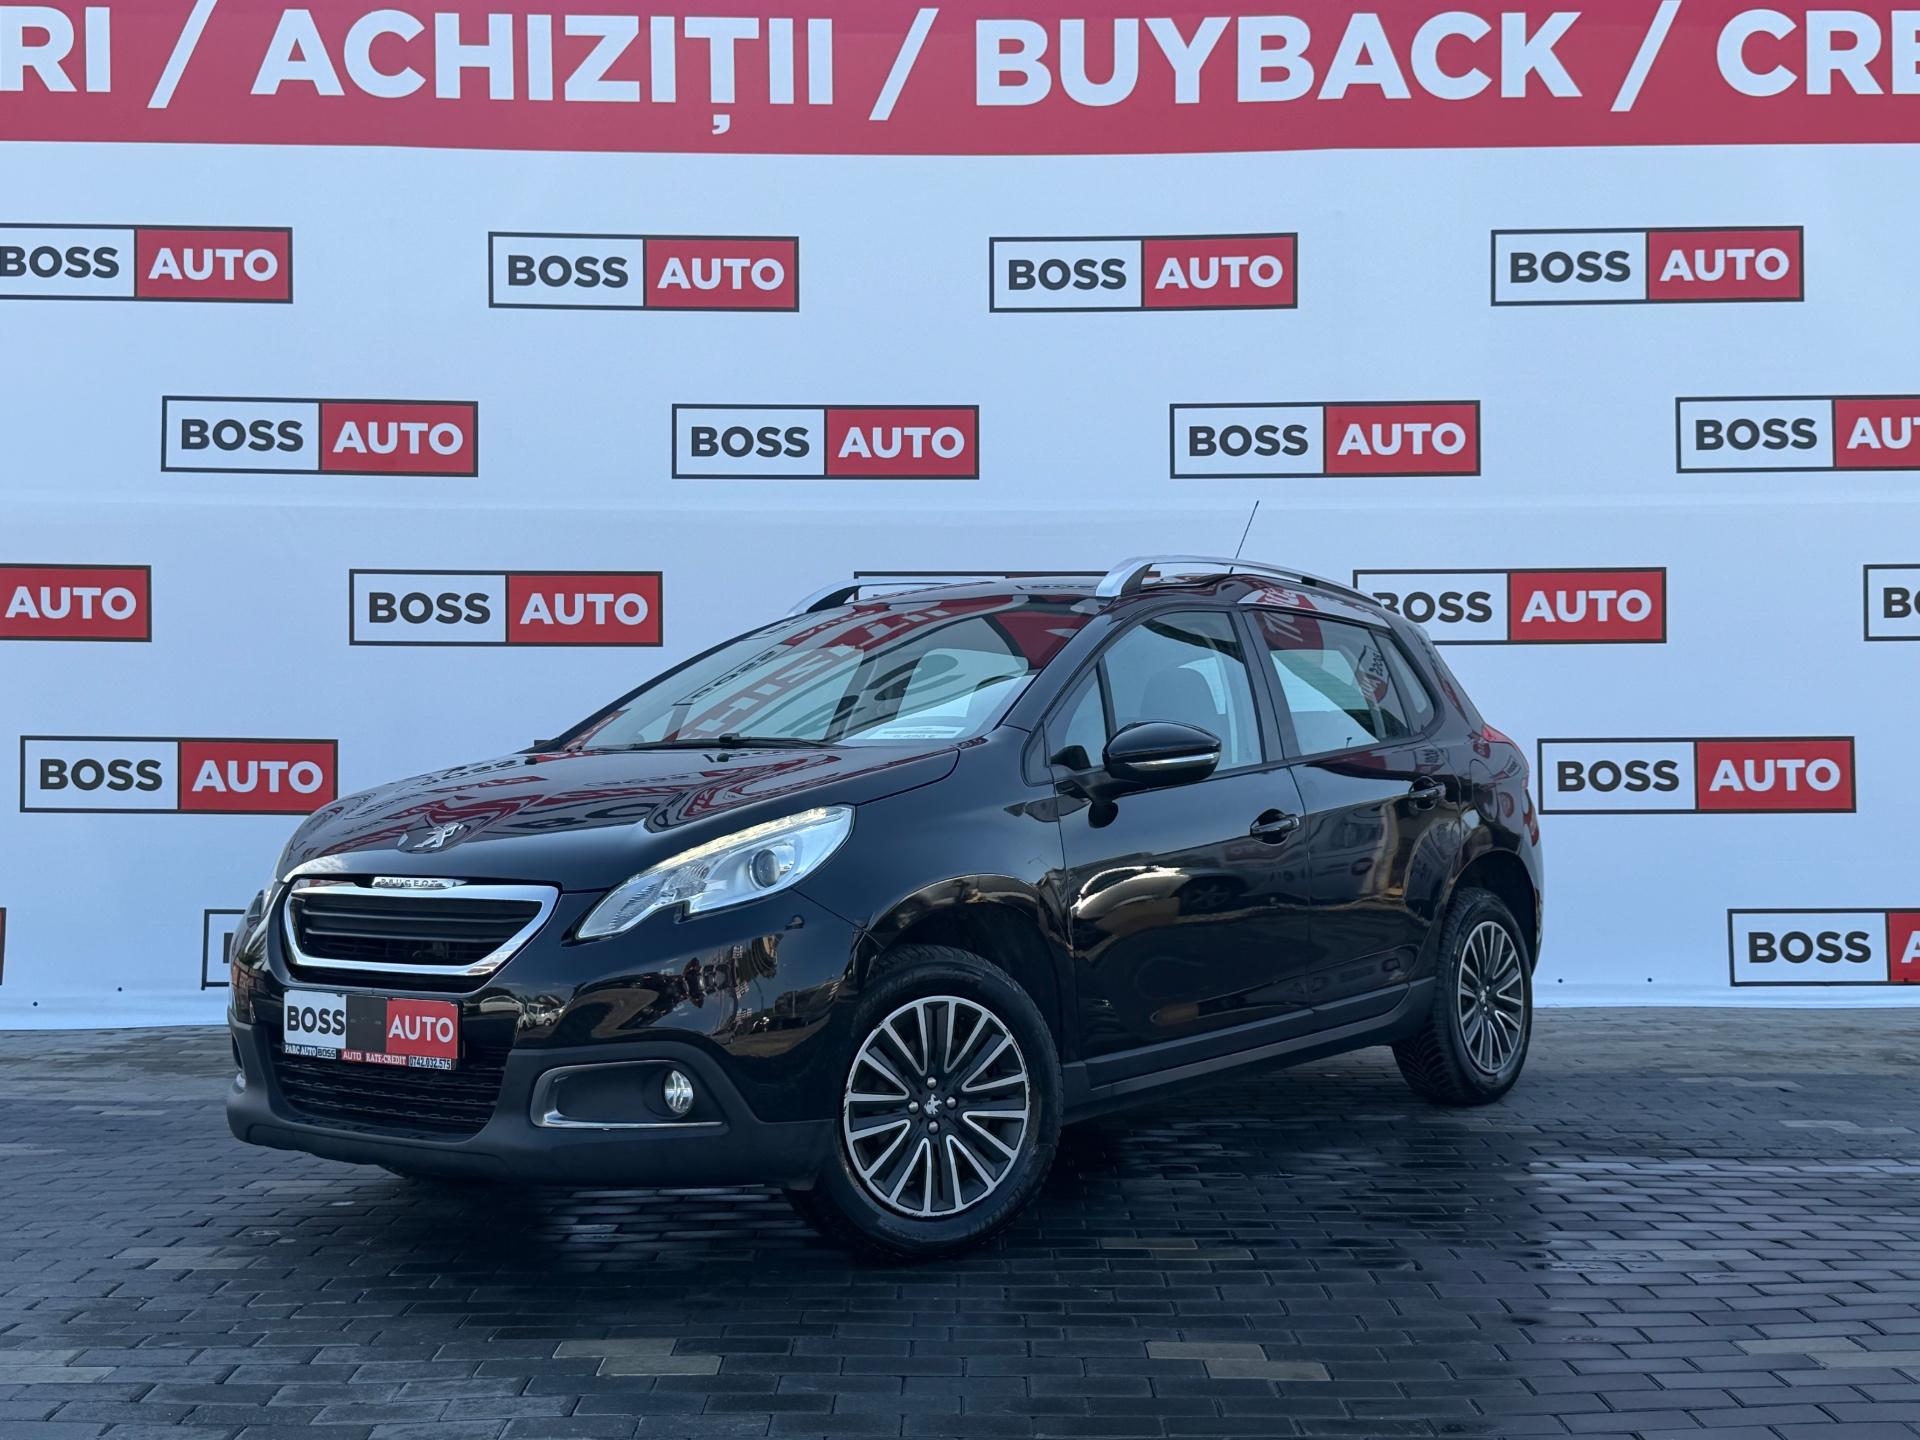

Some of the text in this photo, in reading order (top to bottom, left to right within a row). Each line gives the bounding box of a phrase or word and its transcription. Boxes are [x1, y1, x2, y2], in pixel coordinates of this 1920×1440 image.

[251, 9, 834, 135] ACHIZIȚII
[976, 12, 1583, 107] BUYBACK
[0, 246, 278, 282] BOSS AUTO
[508, 255, 785, 291] BOSS AUTO
[1008, 255, 1284, 291] BOSS AUTO
[1510, 247, 1790, 284] BOSS AUTO
[181, 418, 464, 456] BOSS AUTO
[691, 426, 965, 459] BOSS AUTO
[1189, 422, 1466, 457] BOSS AUTO
[1695, 416, 1920, 451] BOSS AU
[5, 586, 137, 620] AUTO
[368, 591, 649, 626] BOSS AUTO
[1521, 589, 1652, 623] AUTO
[1883, 587, 1920, 619] B
[39, 758, 323, 794] BOSS AUTO
[1557, 758, 1841, 793] BOSS AUTO
[1748, 930, 1872, 964] BOSS
[286, 1005, 454, 1043] BOSS AUTO
[284, 1043, 300, 1054] PARC
[300, 1046, 317, 1056] AUTO
[342, 1050, 362, 1061] AUTO
[365, 1053, 407, 1065] RATE-CREDIT
